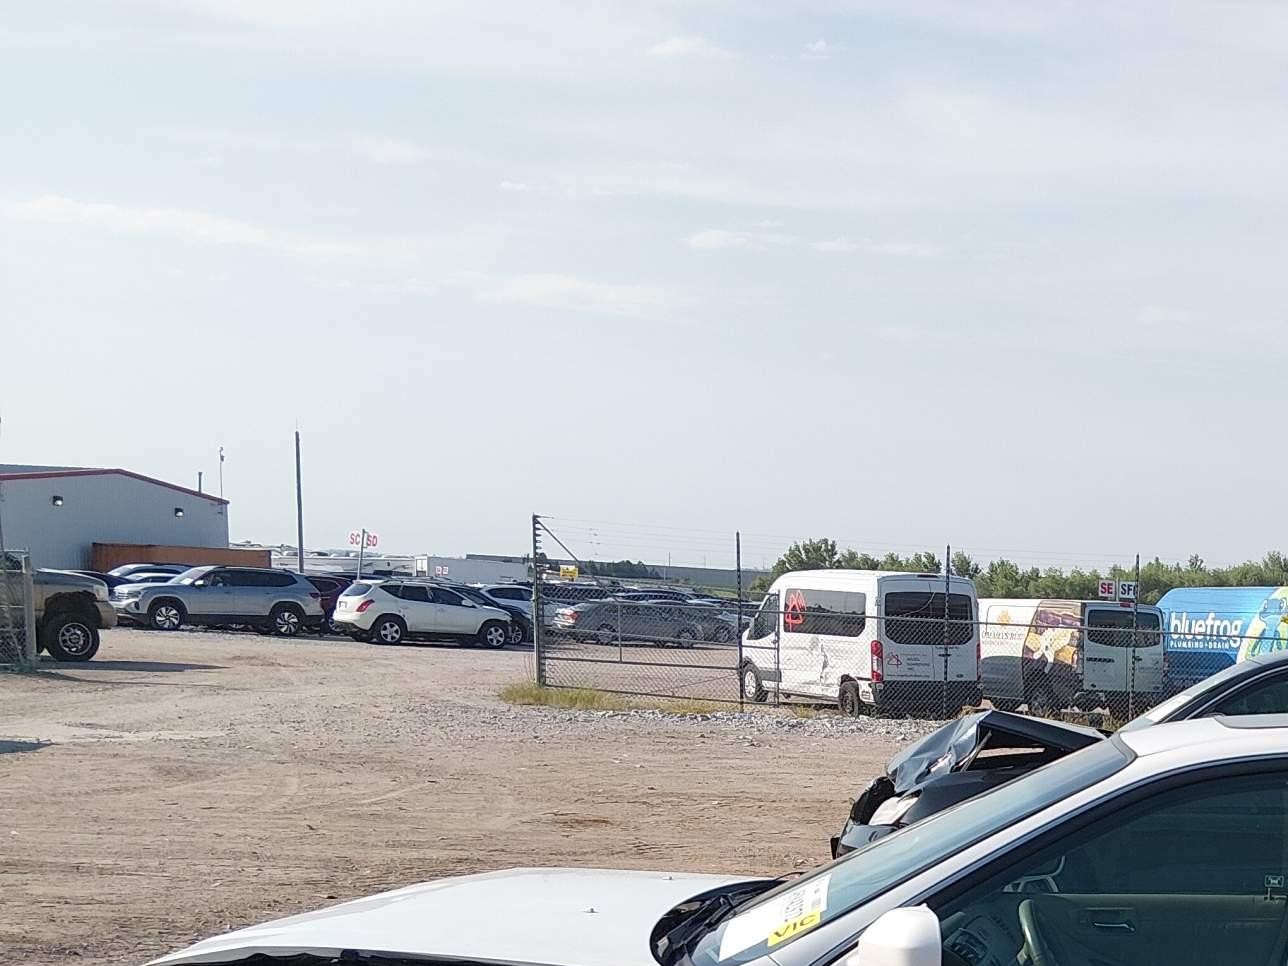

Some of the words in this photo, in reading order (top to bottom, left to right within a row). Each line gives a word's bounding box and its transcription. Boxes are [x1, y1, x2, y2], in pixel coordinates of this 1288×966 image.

[366, 535, 378, 546] SD
[1100, 583, 1113, 594] SE
[1170, 611, 1243, 648] bluefrog
[1170, 640, 1203, 649] PLUMBING
[1208, 641, 1230, 649] DRAIN
